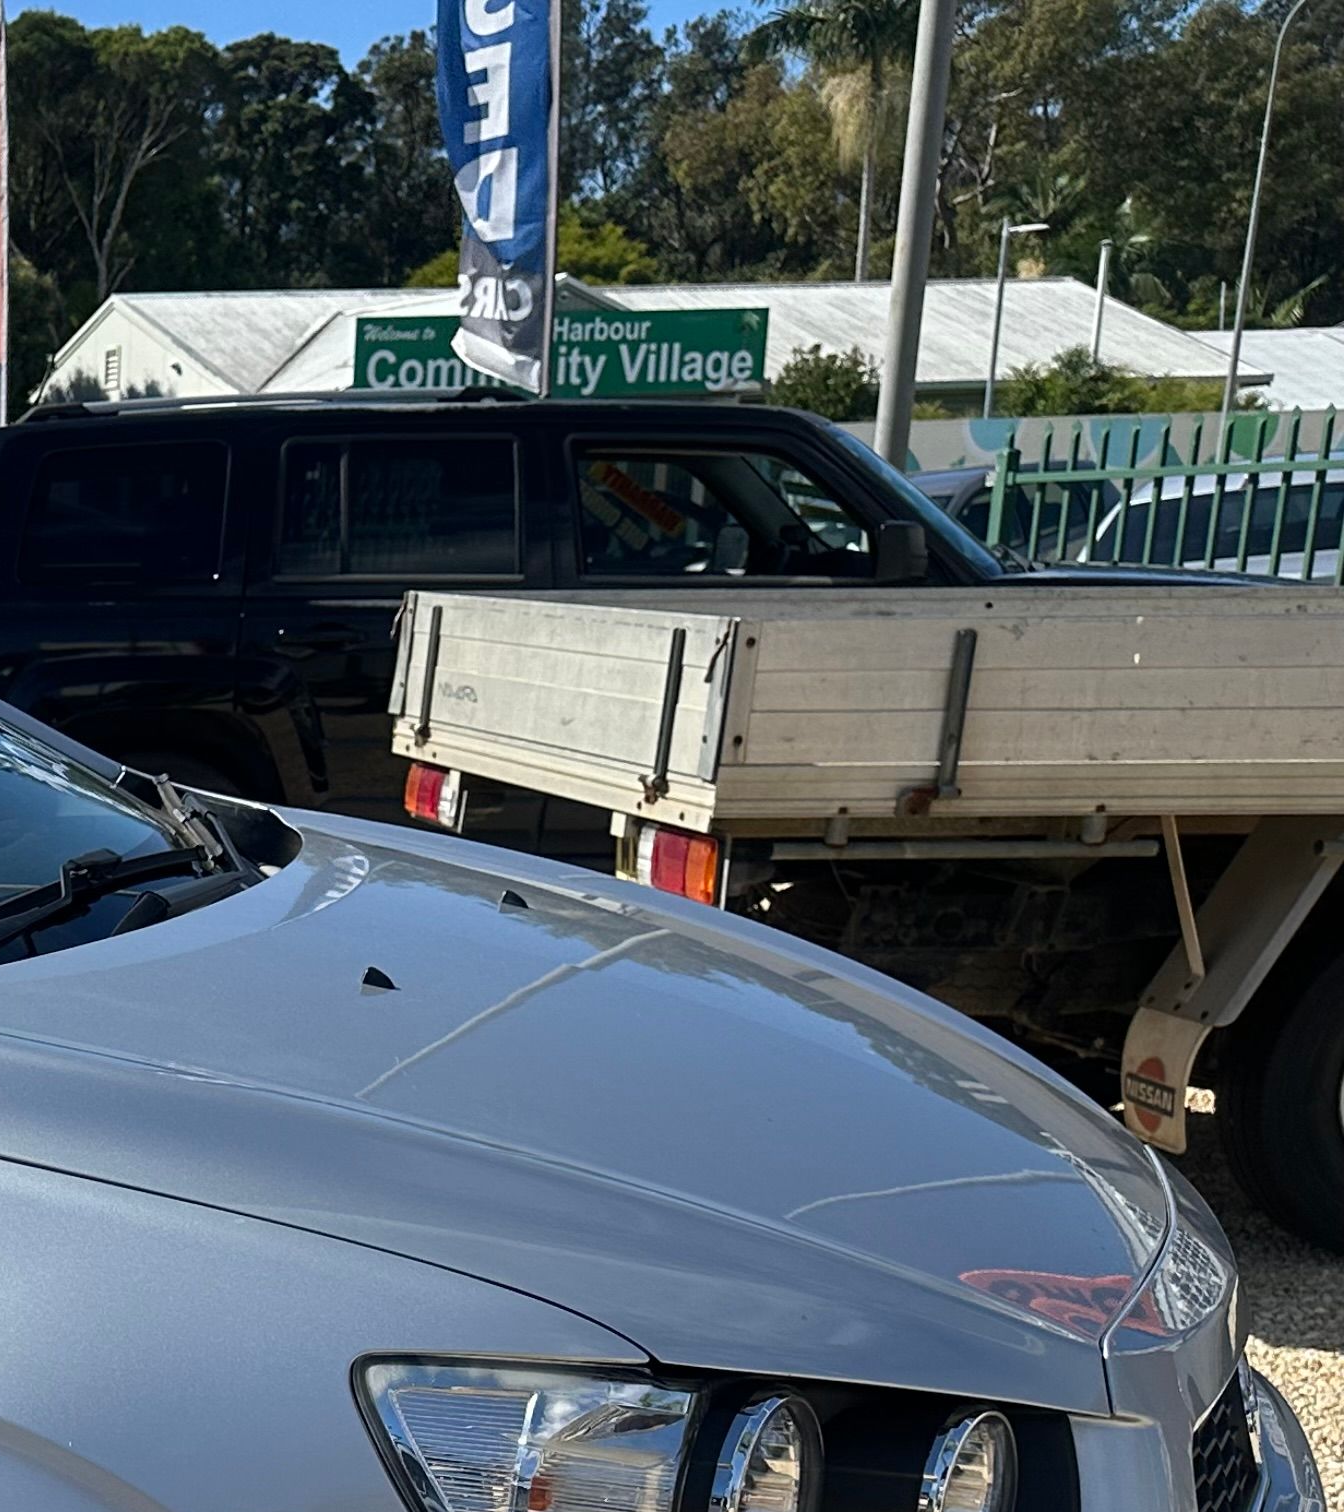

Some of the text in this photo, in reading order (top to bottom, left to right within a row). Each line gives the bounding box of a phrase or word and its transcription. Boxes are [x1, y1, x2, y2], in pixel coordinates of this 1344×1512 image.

[553, 316, 651, 343] Harbour
[618, 342, 754, 392] Village
[1125, 1076, 1173, 1112] NISSAN
